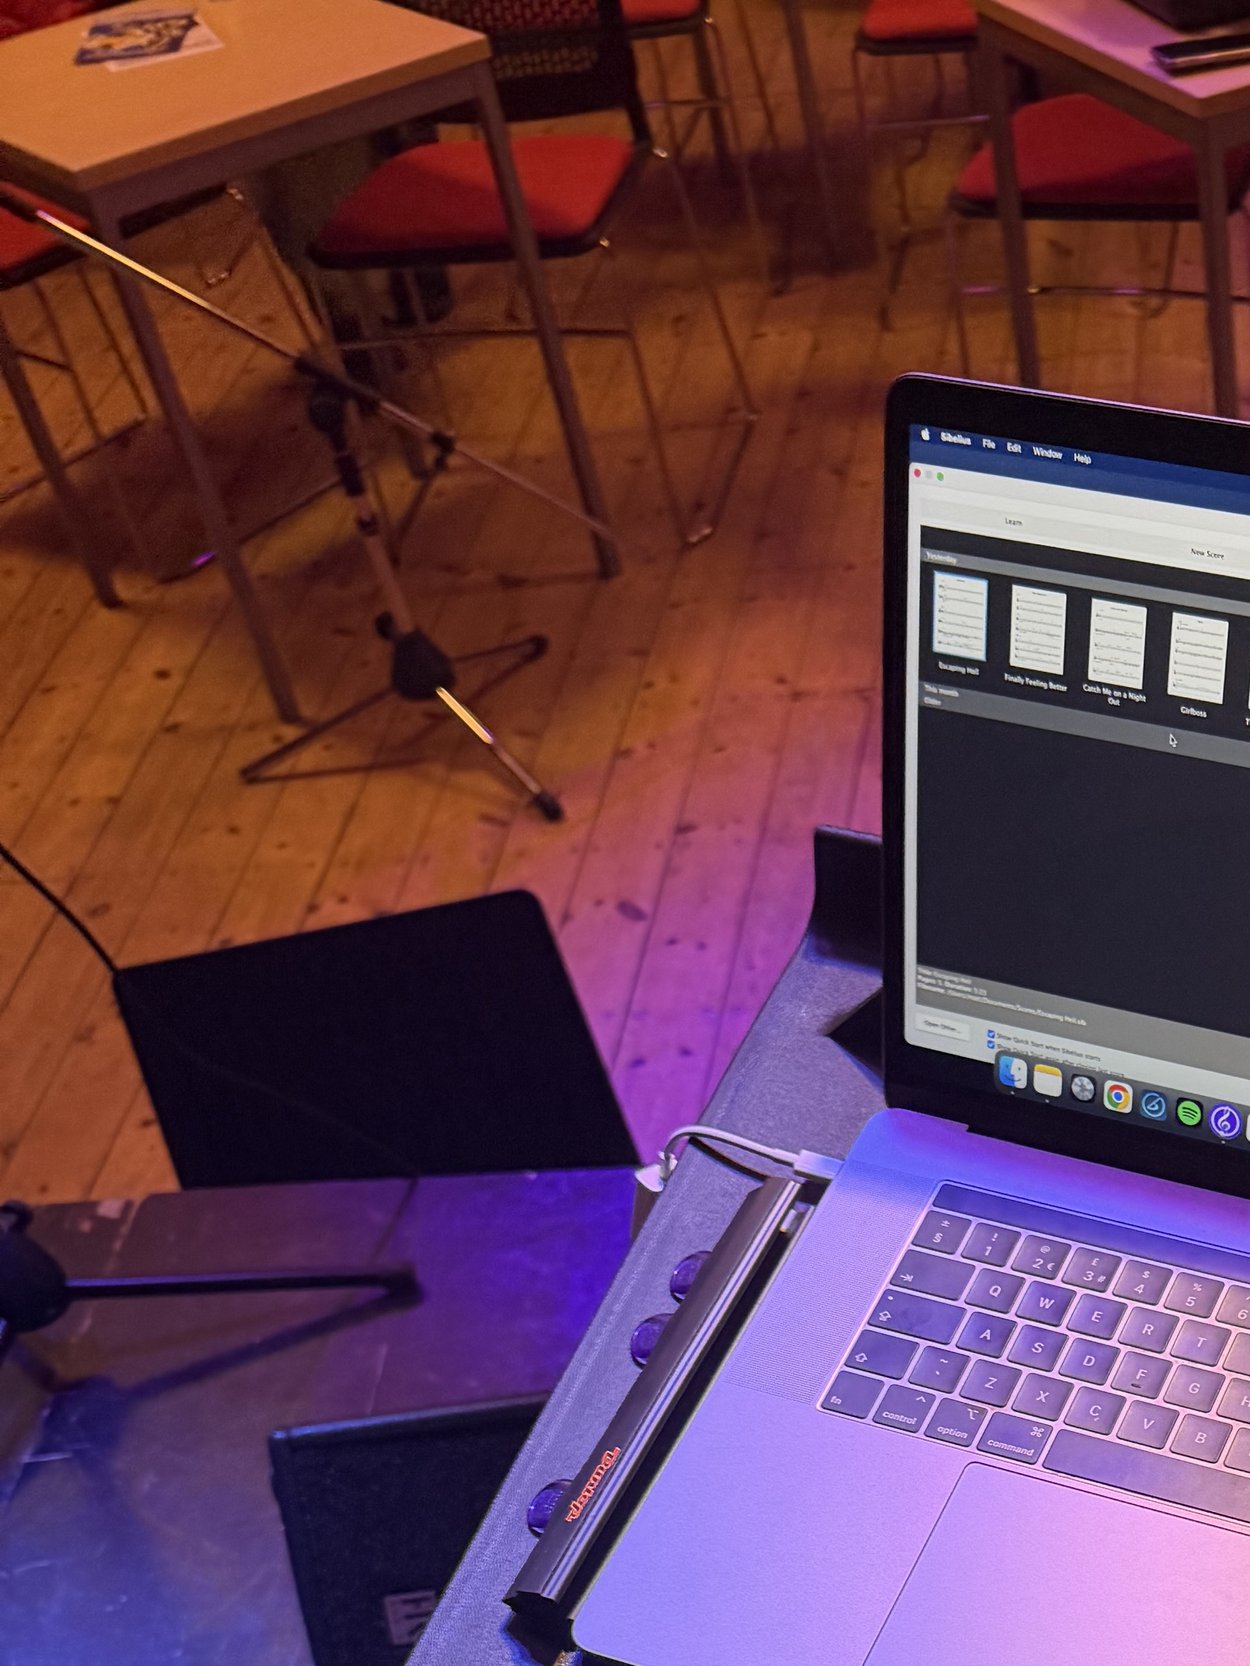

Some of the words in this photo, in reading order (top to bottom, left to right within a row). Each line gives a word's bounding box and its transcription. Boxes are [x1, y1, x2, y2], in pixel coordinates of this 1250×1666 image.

[940, 432, 971, 446] Sibelius
[982, 439, 996, 449] File
[1007, 442, 1022, 454] Edit
[1033, 446, 1063, 460] Window
[1073, 453, 1092, 465] Help
[1004, 517, 1023, 527] Learn
[1190, 547, 1205, 558] New
[1207, 549, 1225, 560] Score
[1004, 673, 1024, 687] Finally
[1025, 676, 1048, 690] Feeling
[1049, 681, 1068, 692] Better
[1082, 683, 1101, 695] Catch
[1102, 687, 1113, 697] Me
[1113, 690, 1122, 698] on
[1128, 692, 1146, 704] Night
[1108, 696, 1120, 707] Out
[1180, 706, 1207, 719] Girlboss
[984, 1246, 993, 1256] 1
[1032, 1258, 1044, 1269] 2
[1083, 1270, 1095, 1281] 3
[989, 1285, 1002, 1298] Q
[1133, 1284, 1145, 1294] 4
[1039, 1297, 1055, 1309] W
[1185, 1296, 1197, 1307] 5
[1091, 1310, 1104, 1323] E
[1237, 1309, 1249, 1320] 6
[979, 1329, 991, 1341] A
[1142, 1323, 1154, 1336] R
[1031, 1342, 1045, 1353] S
[1197, 1336, 1208, 1348] T
[1082, 1355, 1096, 1367] D
[1135, 1369, 1148, 1380] F
[984, 1376, 998, 1389] Z
[1188, 1382, 1201, 1394] G
[830, 1395, 842, 1405] fn
[1036, 1390, 1050, 1403] X
[882, 1408, 917, 1426] control
[1143, 1418, 1155, 1430] V
[937, 1426, 968, 1441] option
[1194, 1431, 1207, 1444] B
[987, 1438, 1035, 1457] command
